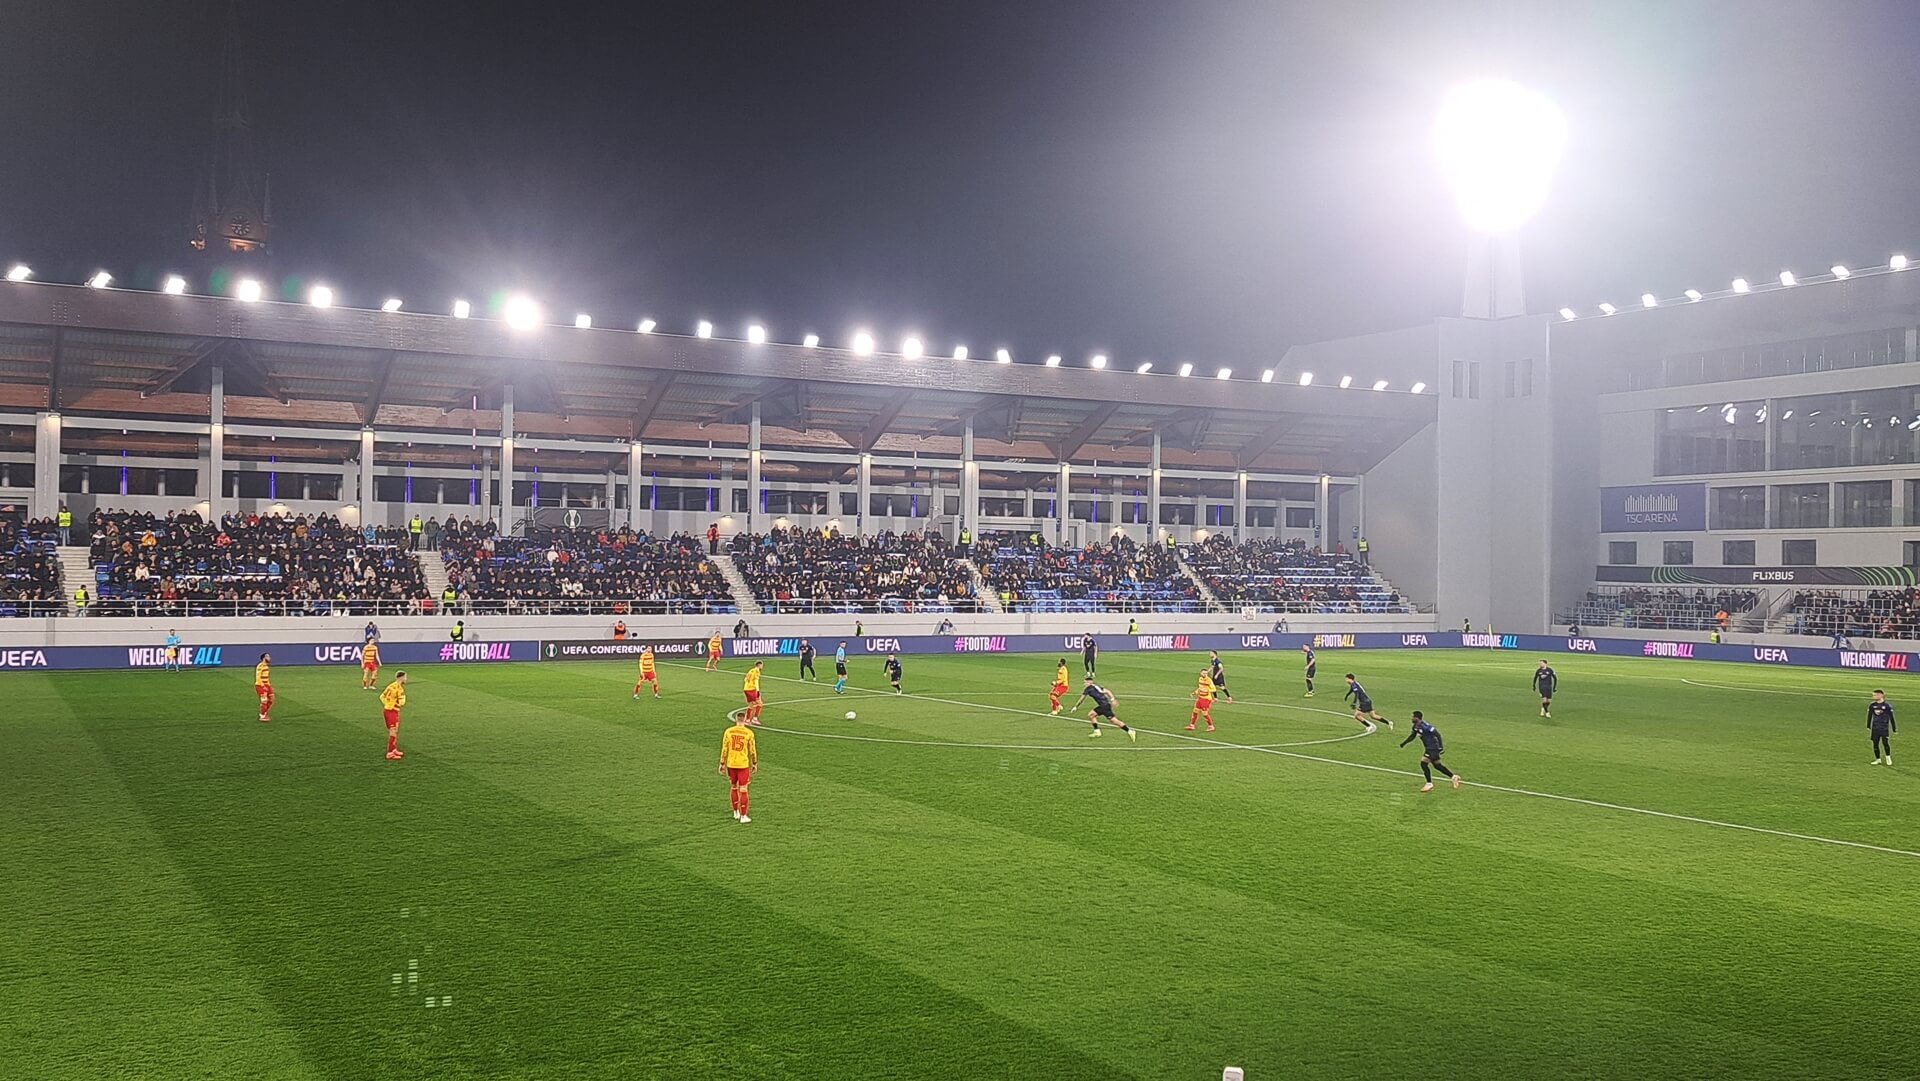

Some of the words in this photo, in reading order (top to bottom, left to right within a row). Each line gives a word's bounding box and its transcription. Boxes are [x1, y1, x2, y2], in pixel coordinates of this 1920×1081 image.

[1625, 514, 1643, 523] TSC
[1644, 513, 1678, 522] ARENA
[733, 640, 778, 655] WELCOME
[779, 639, 799, 654] ALL
[866, 638, 901, 651] UEFA
[954, 637, 1006, 651] #FOOTBALL
[1138, 636, 1173, 649] WELCOME
[1173, 635, 1190, 648] ALL
[1242, 636, 1270, 647] UEFA
[1313, 634, 1355, 647] #FOOTBALL
[1402, 635, 1428, 645] UEFA
[1462, 634, 1501, 646] WELCOME
[1501, 635, 1517, 648] ALL
[1568, 639, 1596, 651] UEFA
[315, 646, 362, 661] UEFA
[440, 643, 511, 660] #FOOTBALL
[562, 647, 588, 655] UEFA
[589, 645, 647, 654] CONFERENC
[1643, 642, 1693, 657] #FOOTBALL
[1754, 648, 1788, 661] UEFA
[128, 648, 193, 666] WELCME
[193, 648, 222, 664] ALL
[1840, 652, 1886, 668] WELCOME
[1886, 654, 1907, 669] ALL
[731, 735, 745, 752] 15
